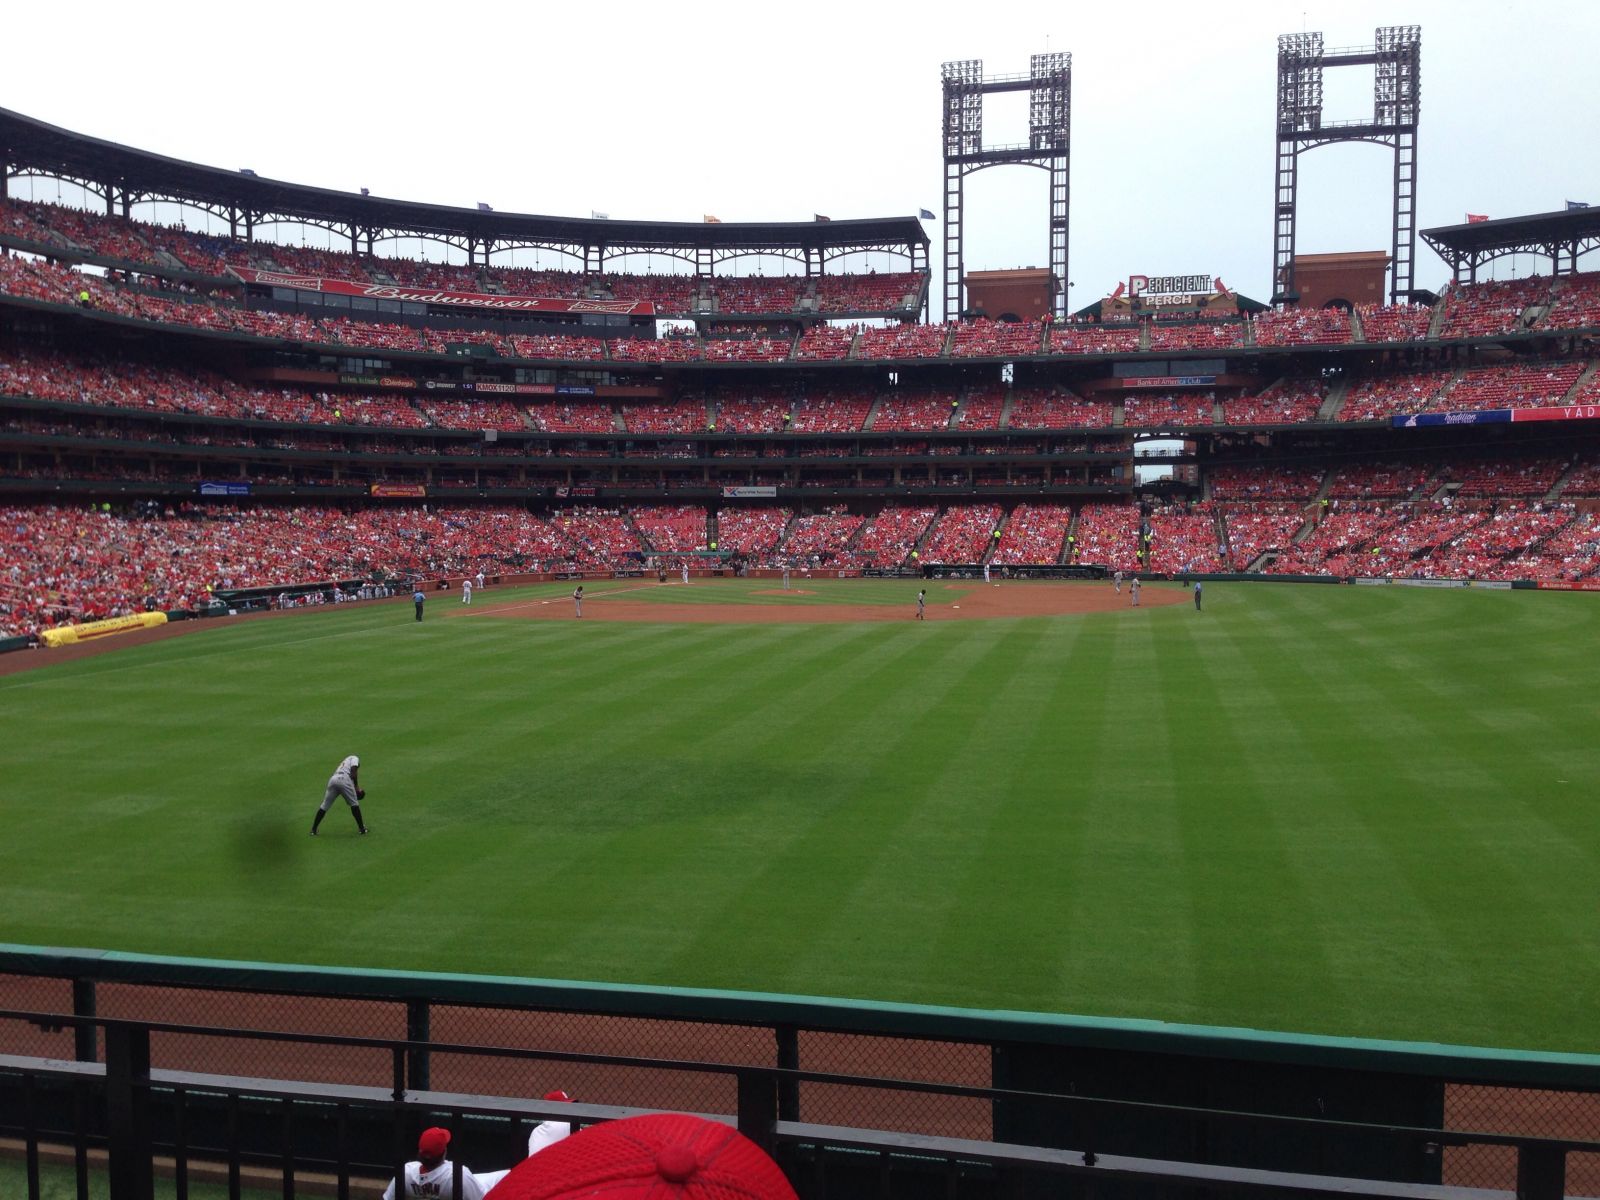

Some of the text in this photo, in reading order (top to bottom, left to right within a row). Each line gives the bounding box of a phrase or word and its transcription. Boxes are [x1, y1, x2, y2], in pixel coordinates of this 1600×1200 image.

[1129, 274, 1210, 298] PERFICIENT
[357, 283, 540, 309] Budweiser
[1145, 294, 1192, 306] PERCH
[1153, 378, 1160, 386] of
[1187, 377, 1201, 385] Club
[1444, 412, 1477, 421] Tradition
